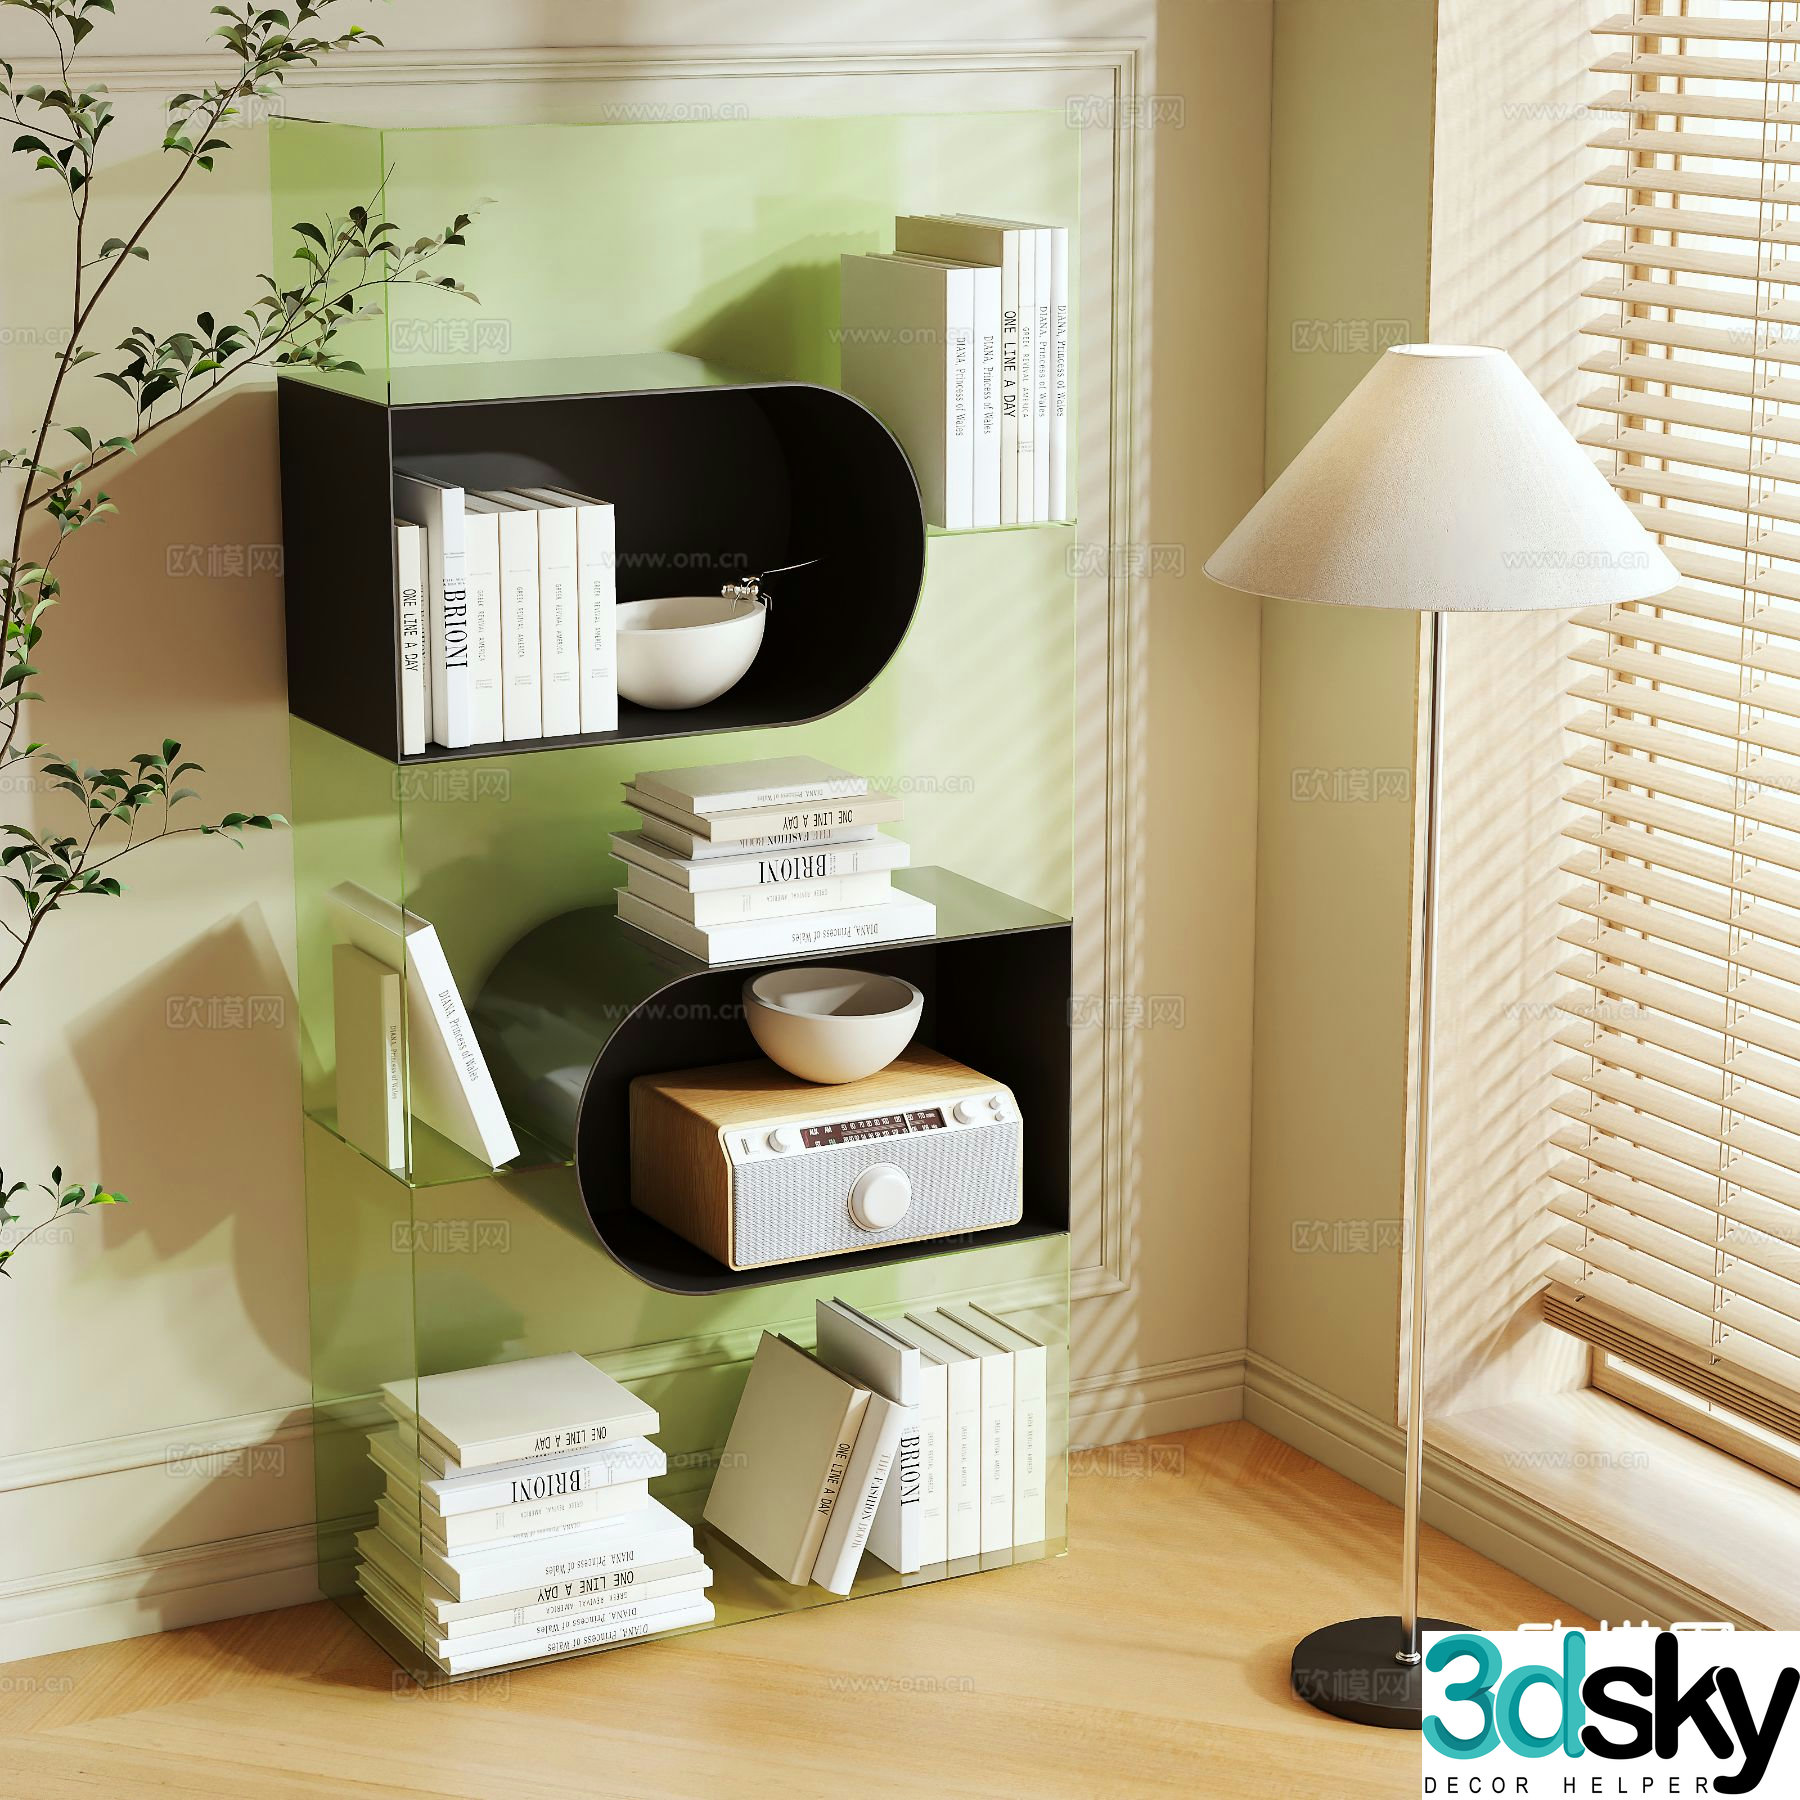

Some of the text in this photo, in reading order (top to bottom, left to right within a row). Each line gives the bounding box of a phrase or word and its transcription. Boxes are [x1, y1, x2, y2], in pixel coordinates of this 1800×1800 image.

[982, 336, 994, 364] DIANA,
[1039, 342, 1047, 377] Princess
[1004, 311, 1016, 418] ONE LINE A DAY
[984, 367, 994, 400] Princess
[1039, 393, 1047, 417] Wales
[984, 411, 994, 435] Wales
[403, 589, 417, 607] ONE
[404, 614, 417, 637] LINE
[444, 590, 467, 669] BRIONI
[405, 654, 418, 671] DAY
[783, 810, 853, 830] ONE LINE A DAY
[759, 854, 826, 884] BRIONI
[792, 932, 812, 943] Wales
[814, 931, 820, 939] of
[823, 928, 851, 938] Princess
[450, 1018, 467, 1050] Princess
[462, 1051, 473, 1059] of
[466, 1059, 479, 1082] Wales
[535, 1427, 607, 1452] ONE LINE A DAY
[836, 1444, 850, 1460] ONE
[828, 1464, 844, 1484] LINE
[901, 1437, 920, 1507] BRIONI
[512, 1470, 580, 1504] BRIONI
[818, 1498, 833, 1516] DAY
[546, 1566, 566, 1575] Wales
[568, 1562, 575, 1573] of
[577, 1556, 606, 1569] Princess
[538, 1571, 634, 1602] ONE LINE A DAY
[546, 1603, 574, 1614] AMERICA
[536, 1608, 637, 1634] DIANA, Princess of Wales
[548, 1641, 570, 1651] Wales
[572, 1637, 581, 1648] of
[584, 1631, 617, 1643] Princess
